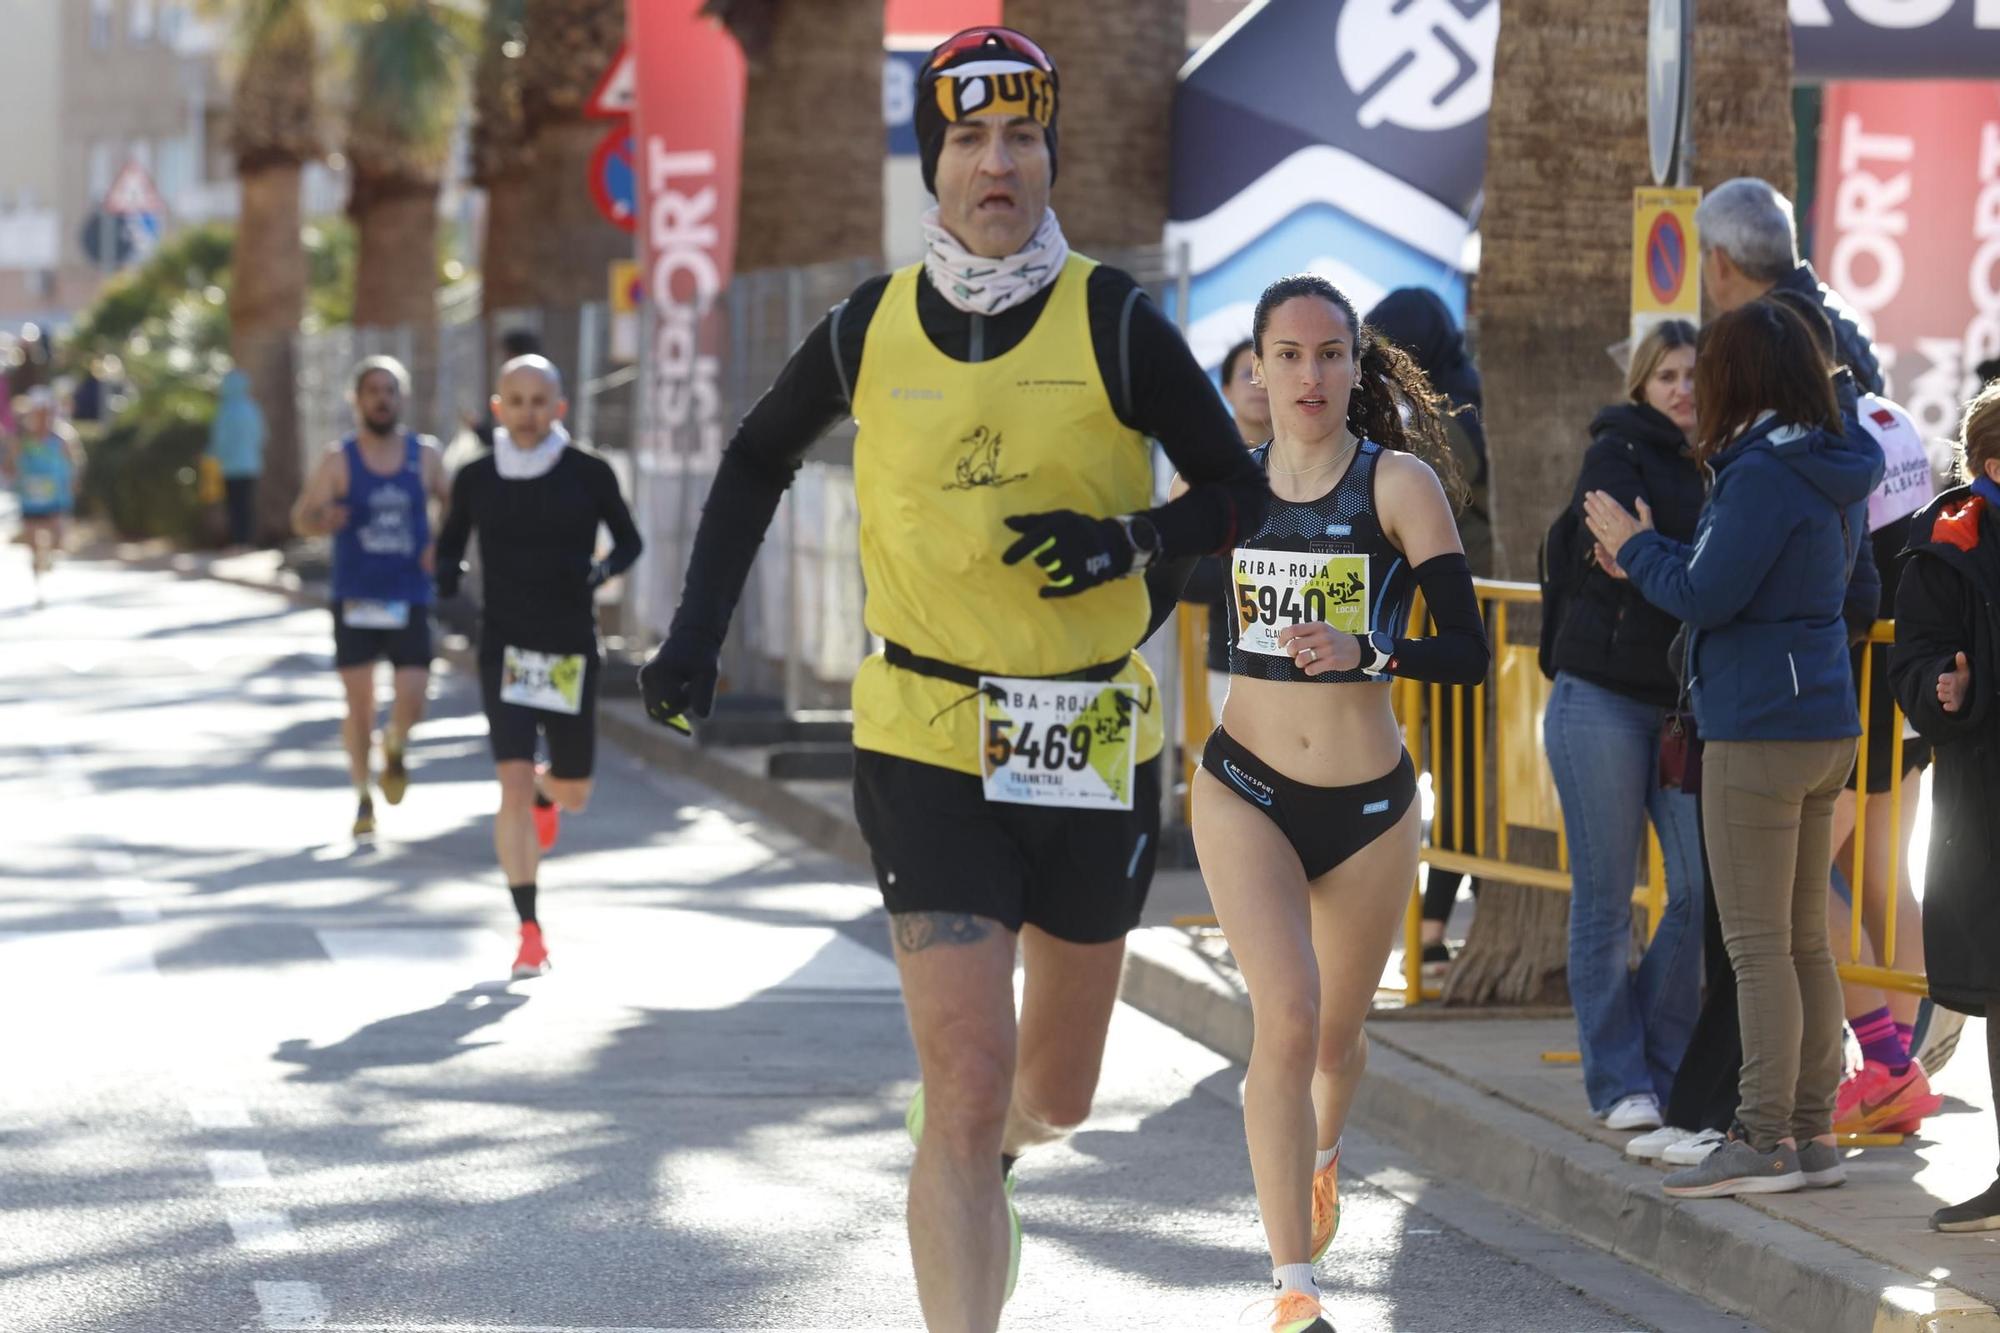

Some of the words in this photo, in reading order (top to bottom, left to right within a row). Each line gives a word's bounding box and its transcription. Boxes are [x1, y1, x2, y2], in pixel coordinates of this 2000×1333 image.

[647, 136, 722, 476] ESPORT
[1238, 583, 1327, 626] 5940
[988, 719, 1092, 771] 5469
